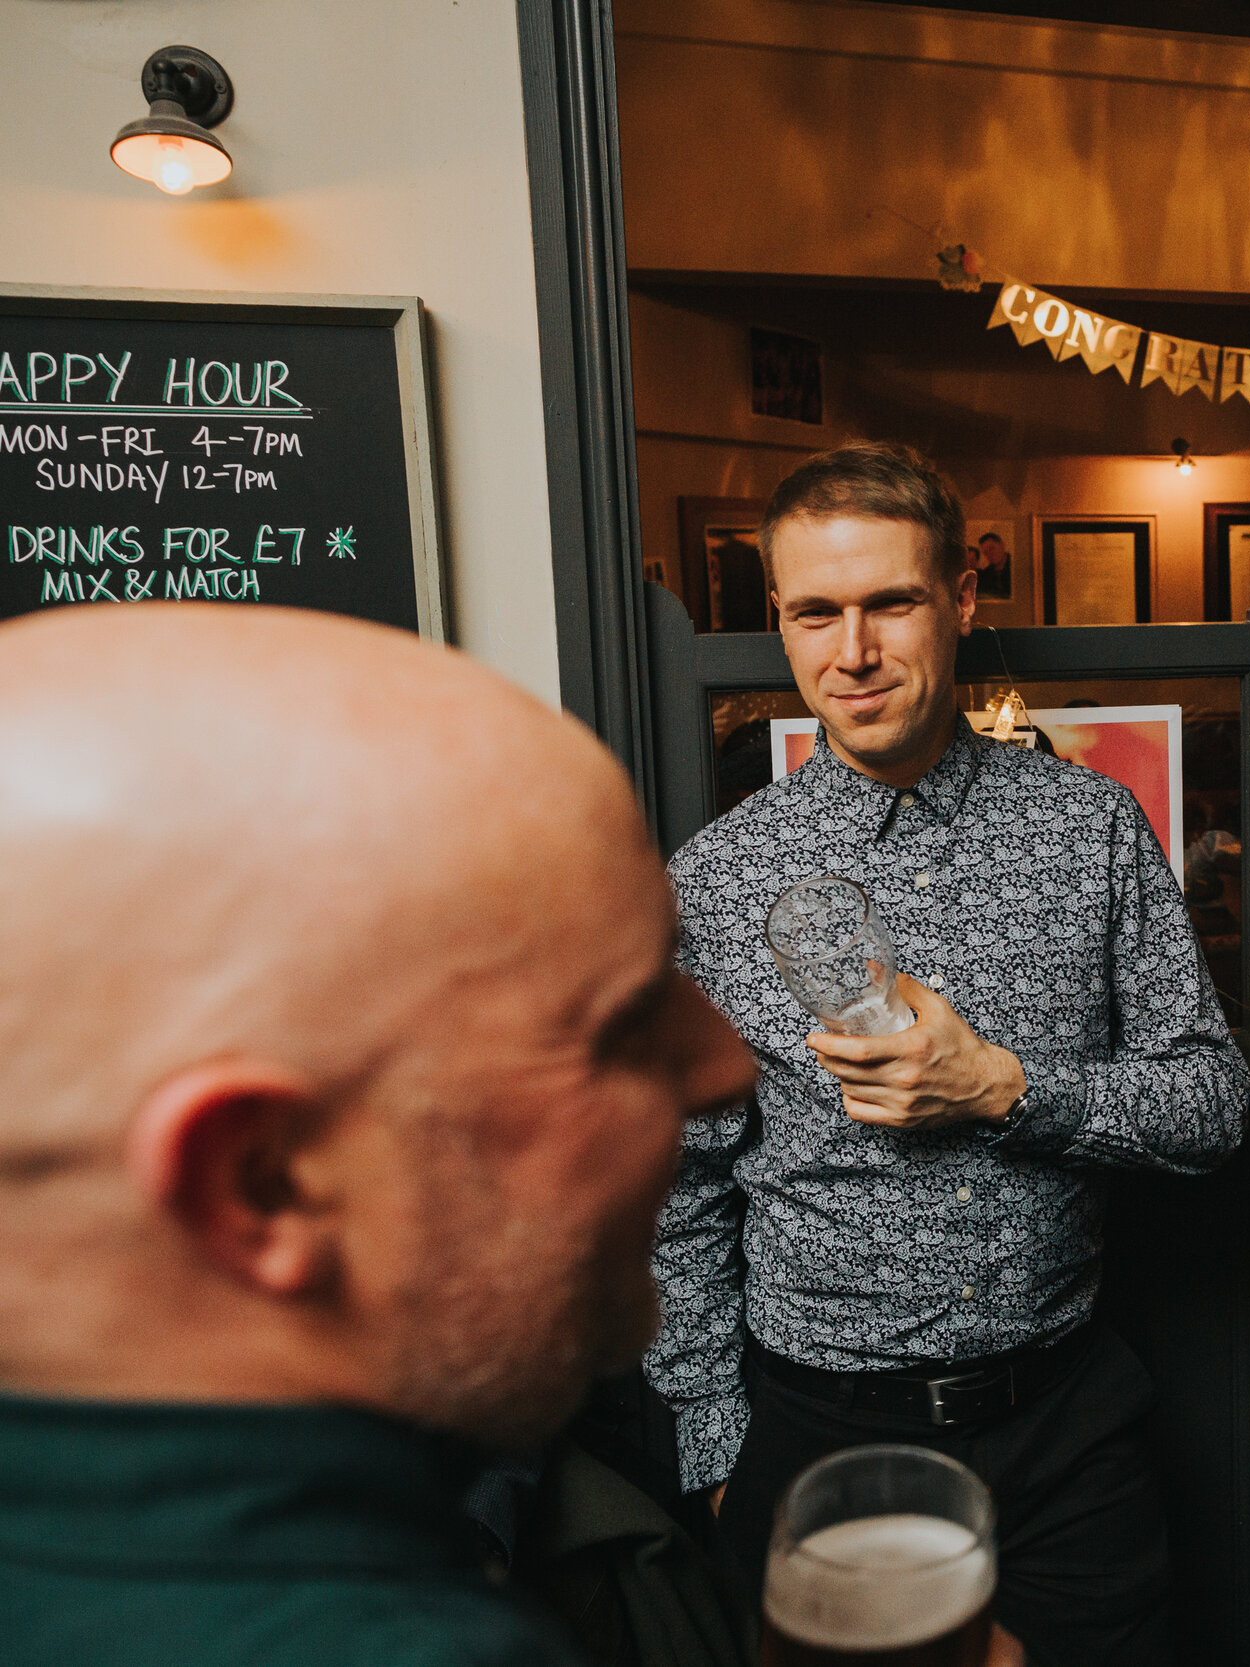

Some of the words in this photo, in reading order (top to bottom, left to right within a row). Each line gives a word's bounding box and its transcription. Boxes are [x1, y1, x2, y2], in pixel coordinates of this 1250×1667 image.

[163, 357, 303, 406] HOUR
[36, 457, 169, 504] SUNDAY
[8, 525, 145, 564] DRINKS
[162, 526, 245, 564] FOR
[252, 524, 306, 565] £7
[41, 568, 121, 603] MIX
[125, 568, 157, 603] &
[165, 564, 261, 603] MATCH
